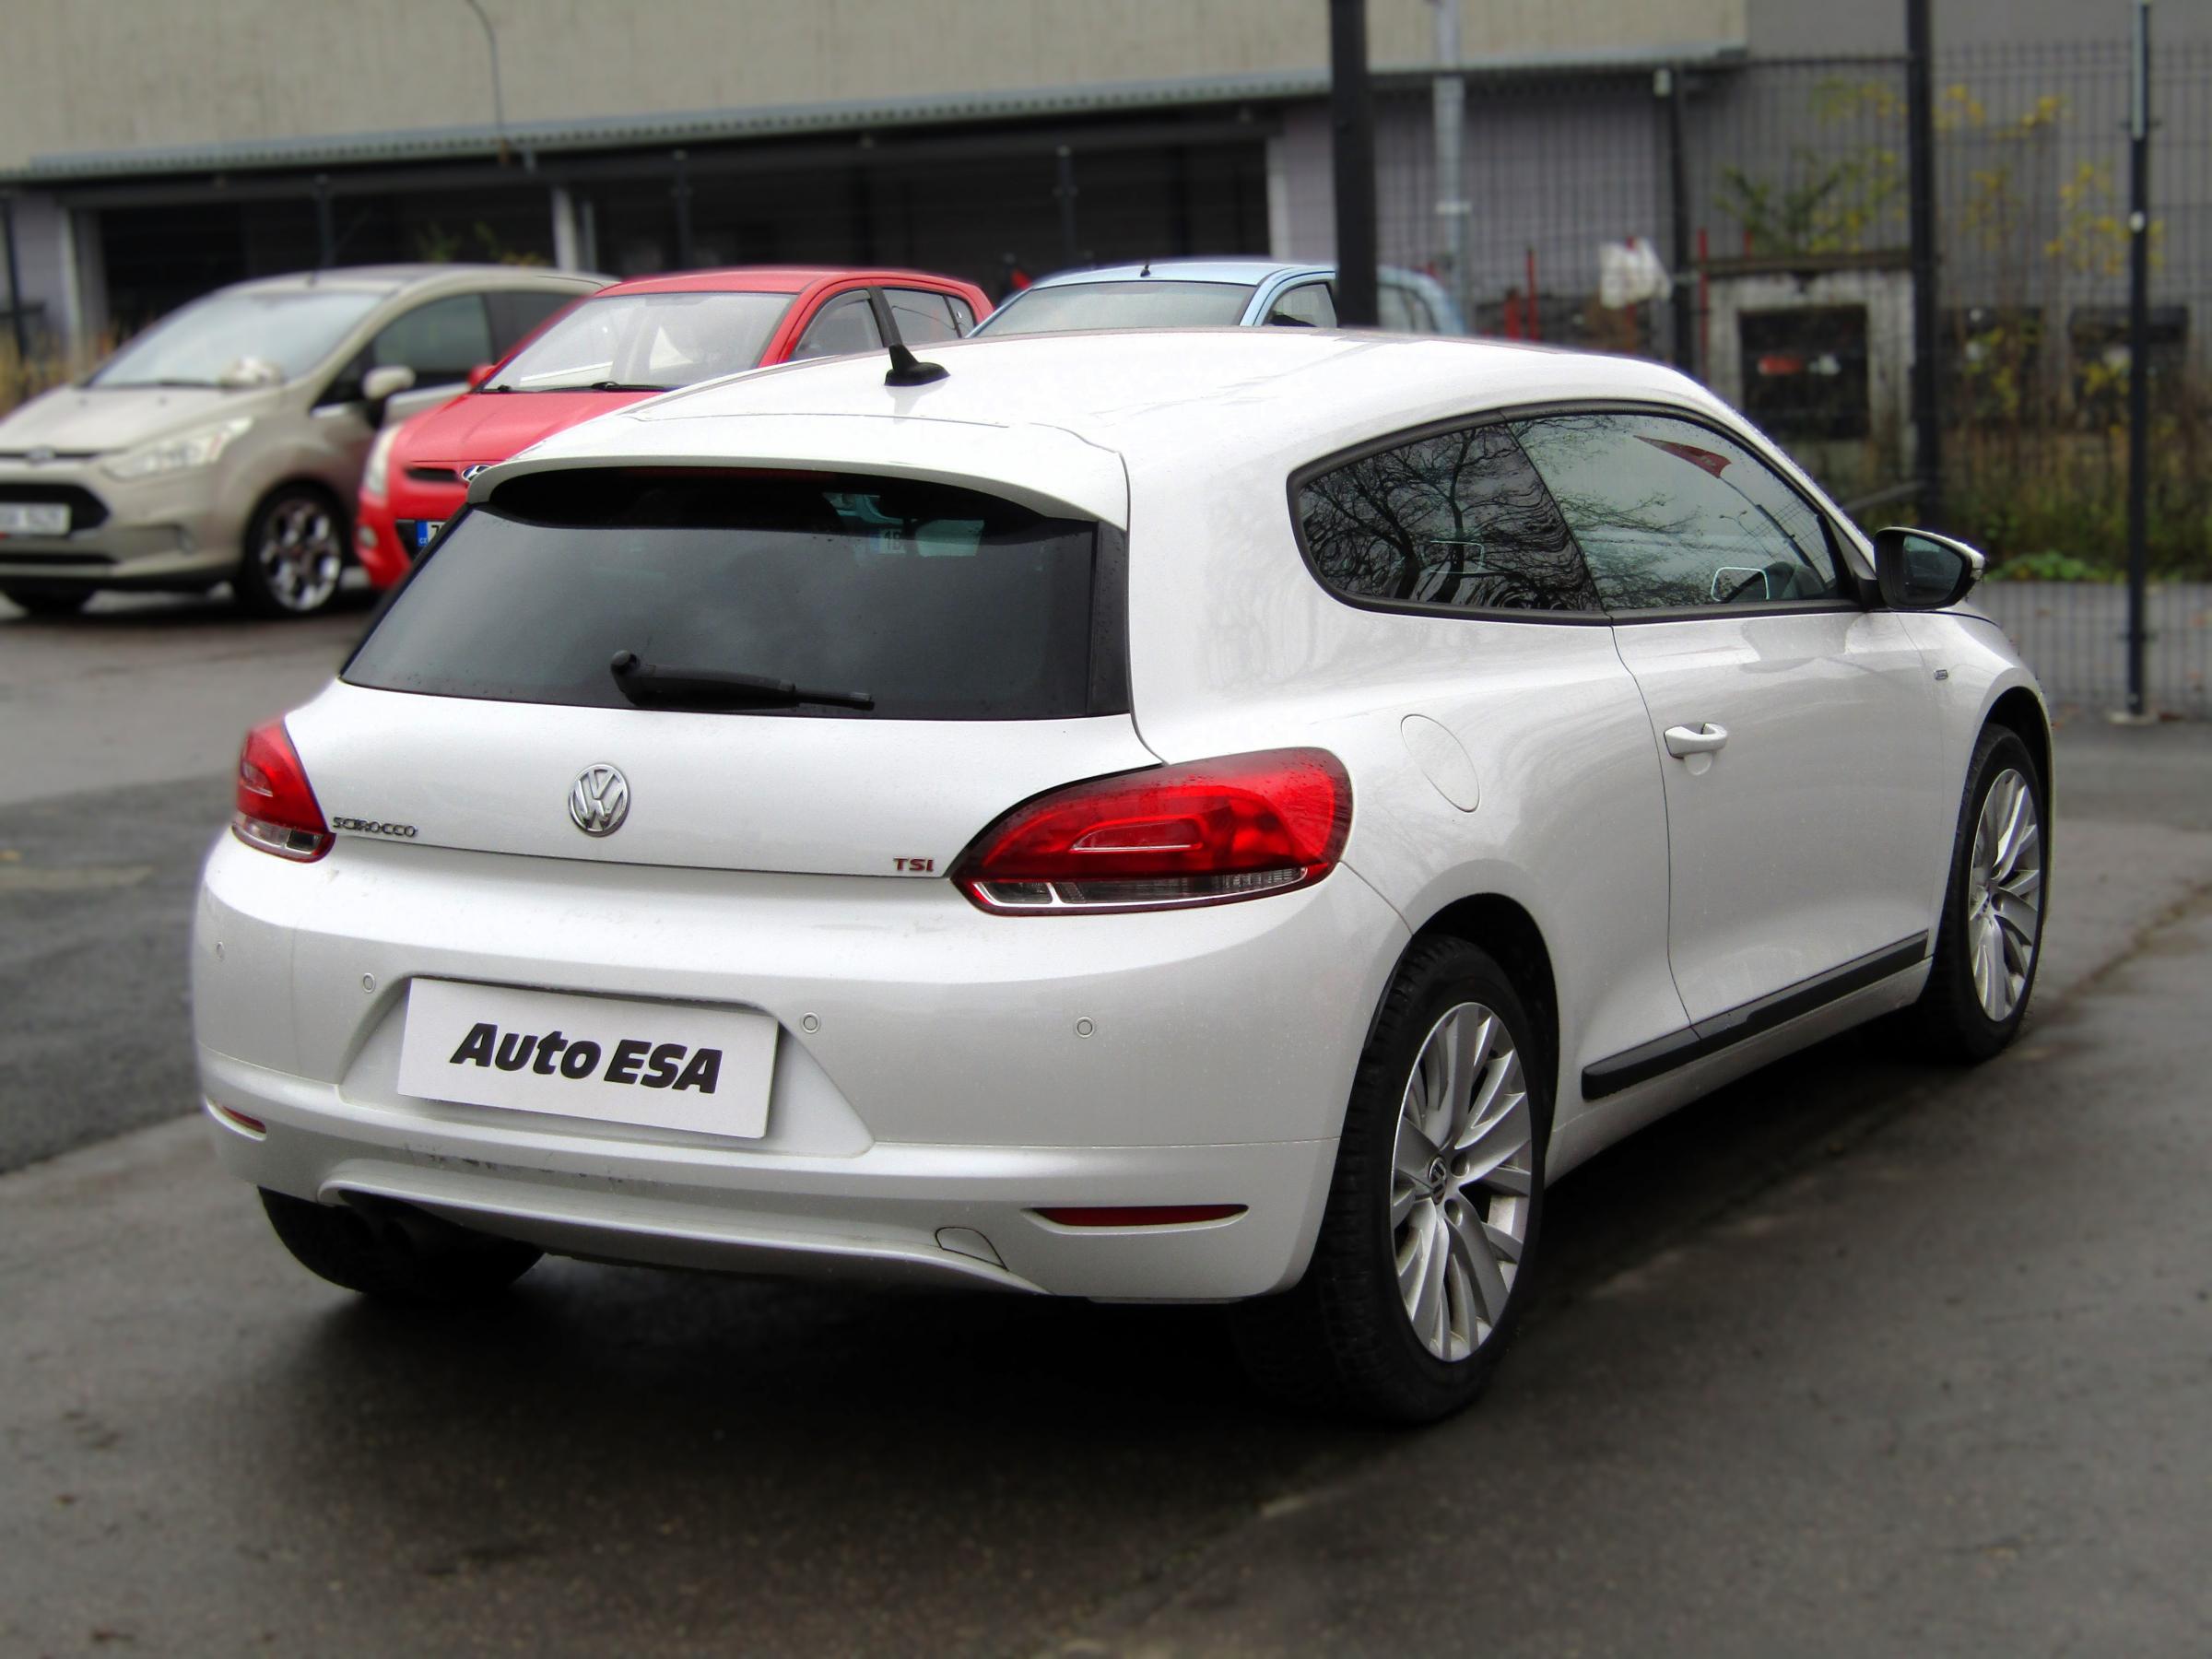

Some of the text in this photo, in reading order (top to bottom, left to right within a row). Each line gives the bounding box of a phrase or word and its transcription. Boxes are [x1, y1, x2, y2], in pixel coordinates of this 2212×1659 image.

[893, 856, 935, 872] TSI
[449, 1022, 723, 1094] Auto ESA
